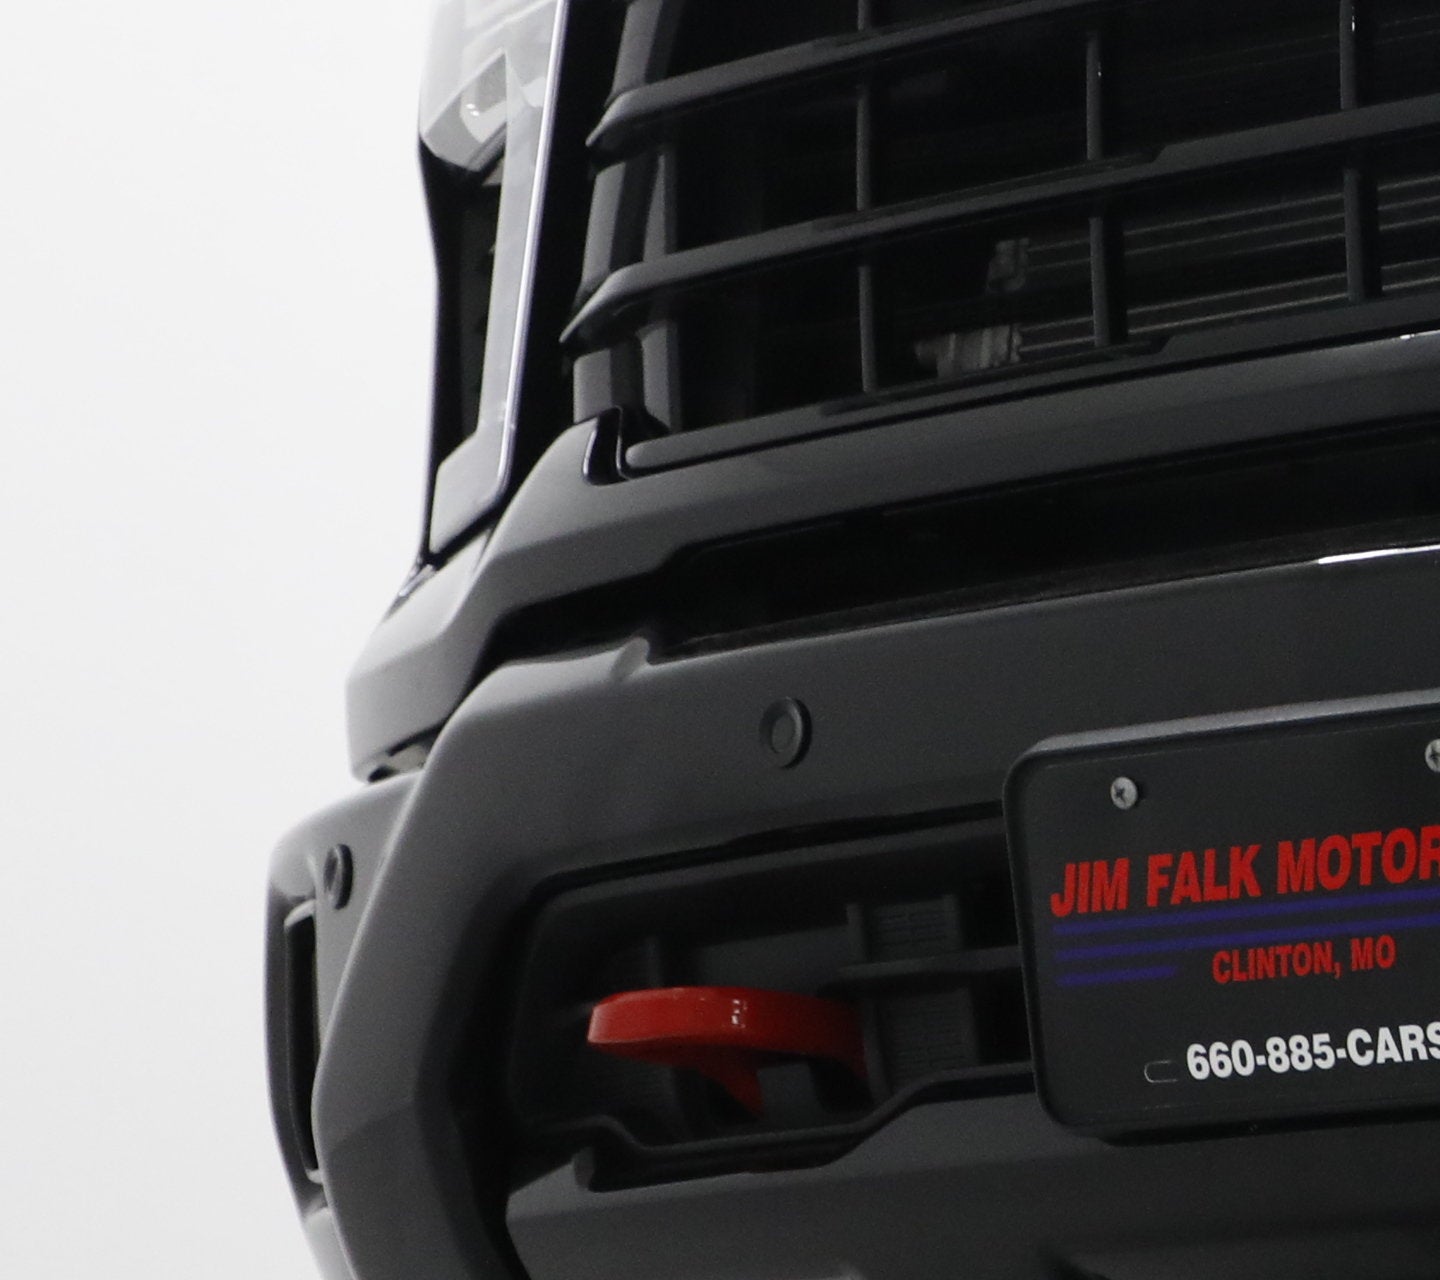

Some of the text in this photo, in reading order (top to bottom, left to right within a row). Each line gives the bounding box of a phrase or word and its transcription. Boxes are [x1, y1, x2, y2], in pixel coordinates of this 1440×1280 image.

[1051, 857, 1130, 918] JIM
[1146, 844, 1262, 907] FALK
[1211, 934, 1396, 984] CLINTON, MO
